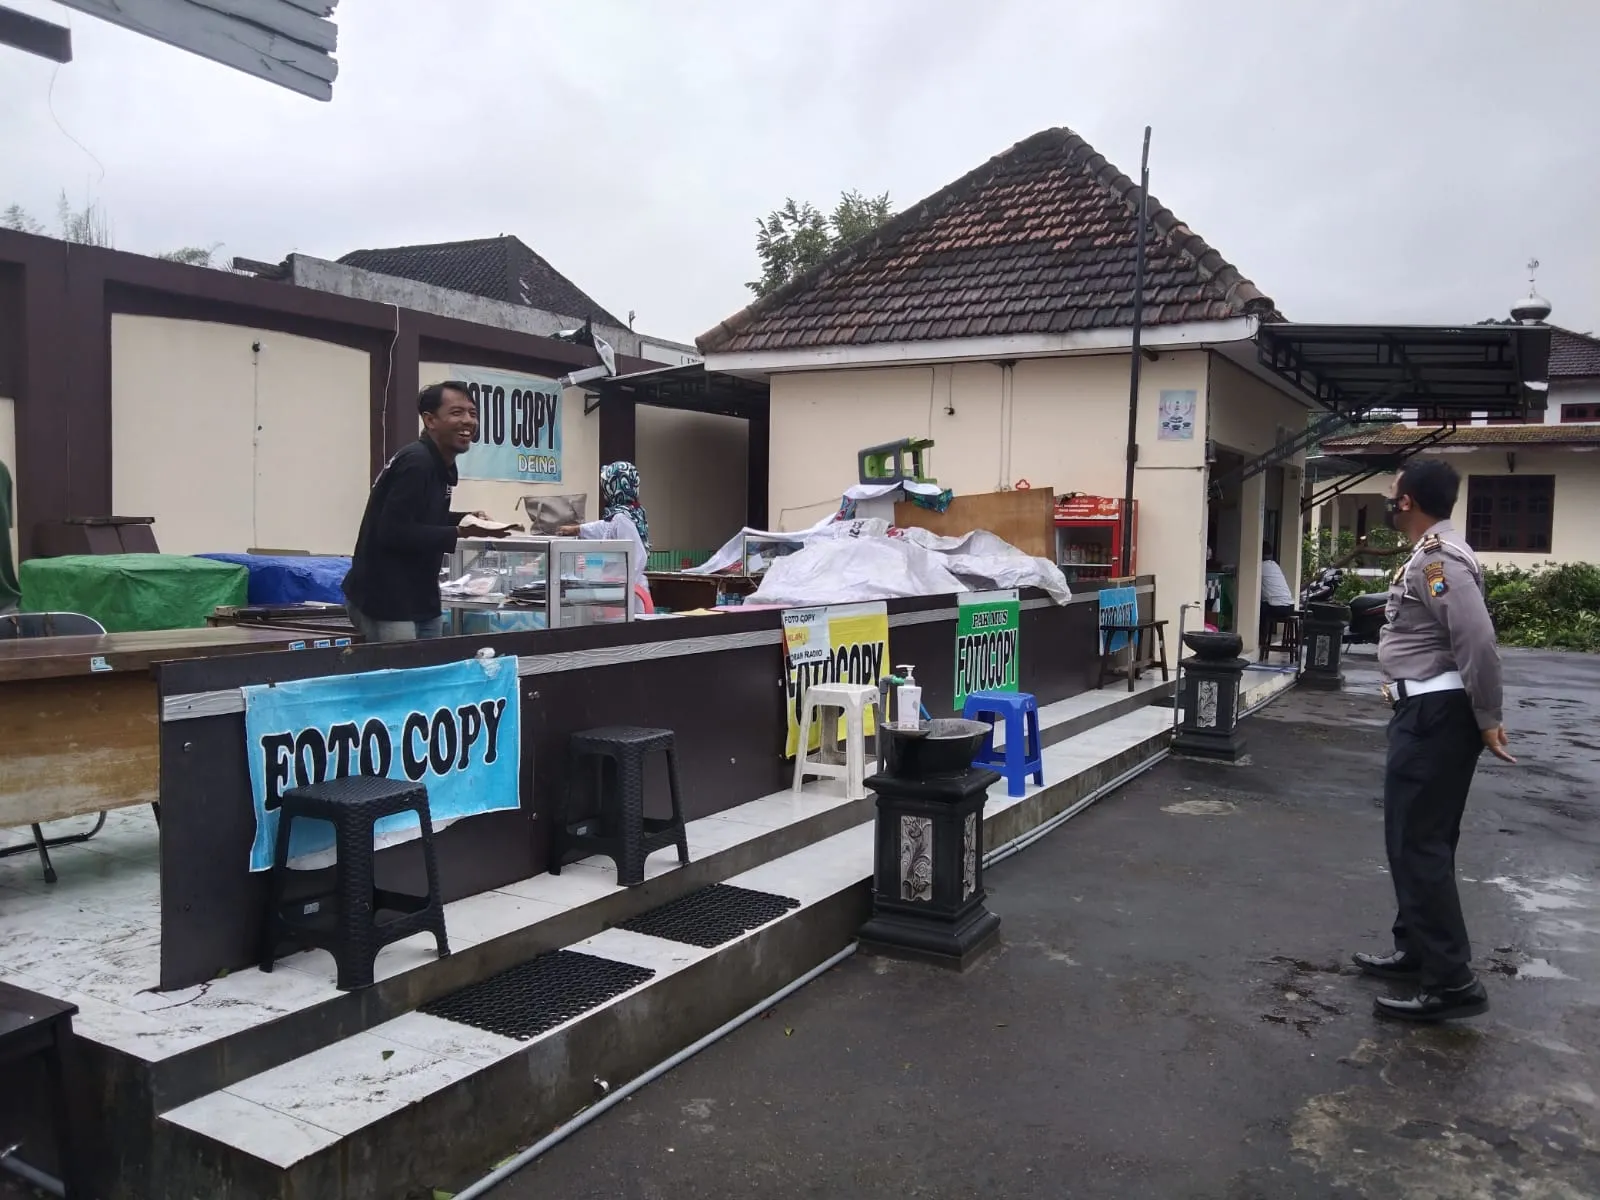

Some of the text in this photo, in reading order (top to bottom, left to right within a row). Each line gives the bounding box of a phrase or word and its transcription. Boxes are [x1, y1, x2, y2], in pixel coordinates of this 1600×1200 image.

[466, 382, 558, 450] OTO COPY
[517, 453, 557, 475] DEINA
[784, 615, 799, 624] FOTO
[972, 610, 1008, 628] PAK MUS
[956, 628, 1018, 697] FOTOCOPY
[260, 697, 506, 813] FOTO COPY
